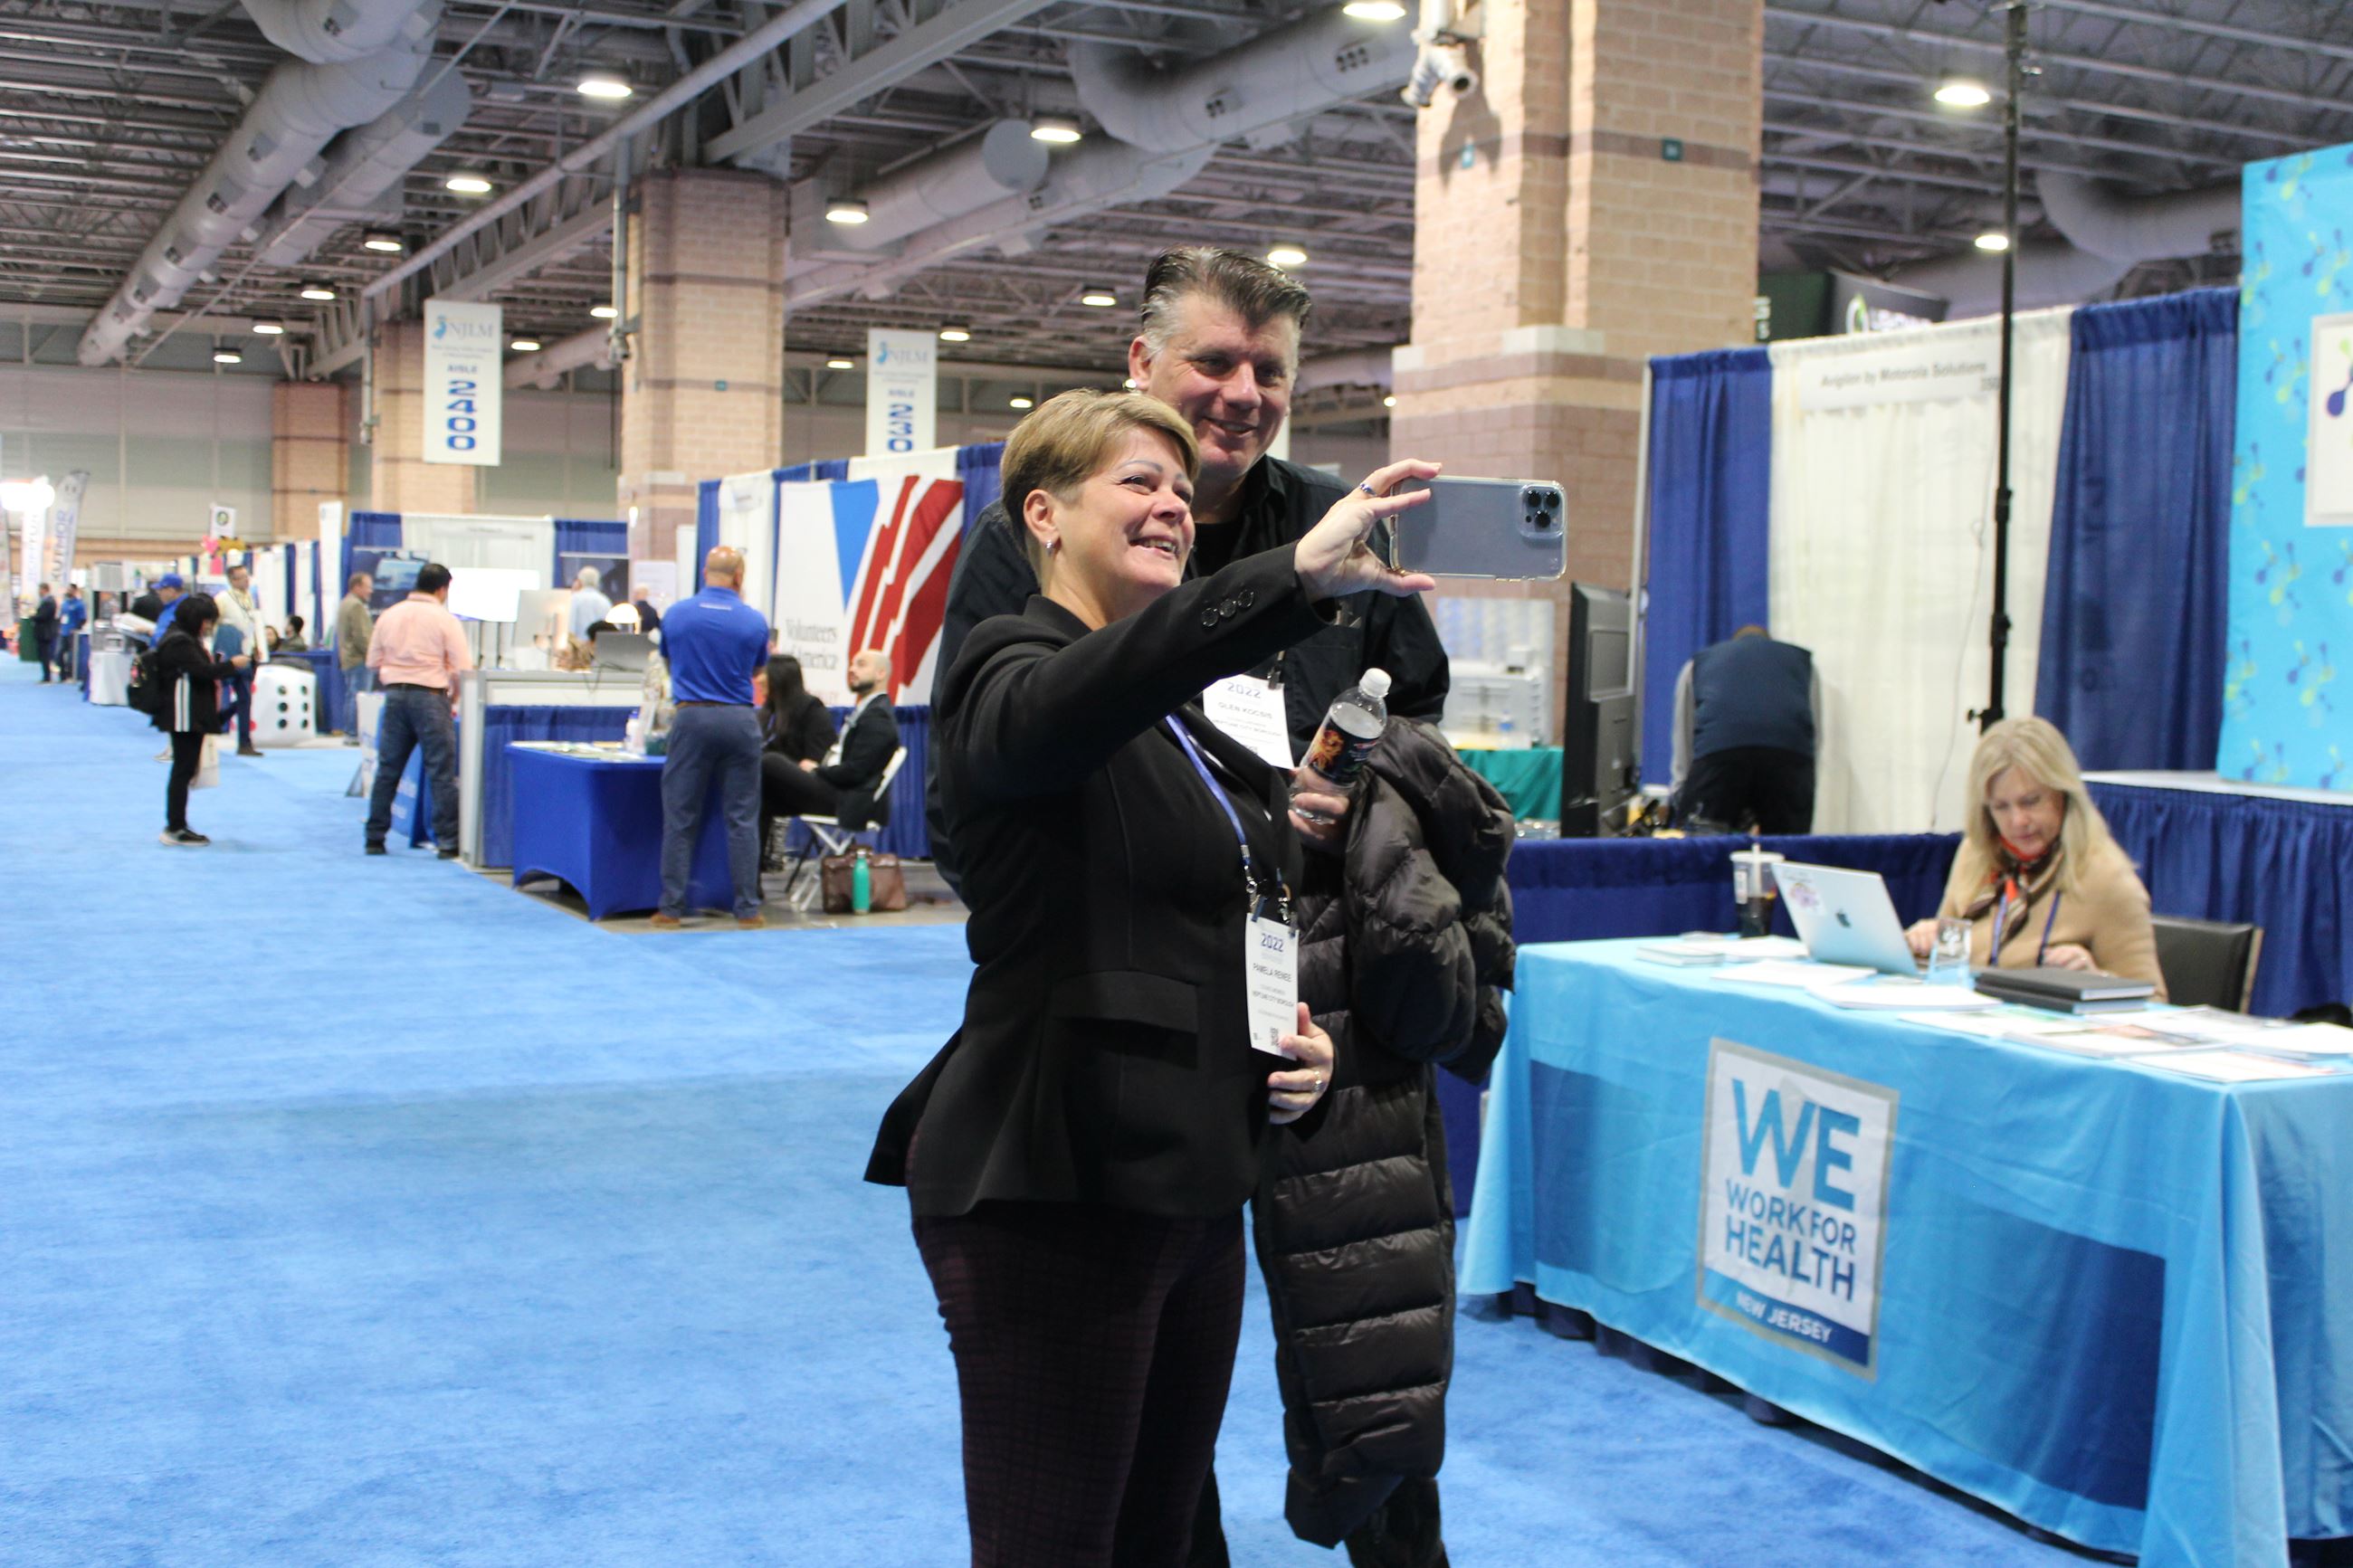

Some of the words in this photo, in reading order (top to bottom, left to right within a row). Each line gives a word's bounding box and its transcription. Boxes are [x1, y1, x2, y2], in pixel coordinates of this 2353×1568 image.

[450, 321, 494, 340] NJLM
[446, 364, 478, 374] AISLE
[446, 380, 478, 451] 2400
[1226, 680, 1262, 699] 2022
[1261, 932, 1284, 953] 2022
[1732, 1078, 1862, 1214] WE
[1725, 1178, 1807, 1237] WORK
[1810, 1210, 1857, 1256] FOR
[1725, 1213, 1854, 1303] HEALTH
[1737, 1290, 1767, 1319] NEW
[1767, 1307, 1834, 1344] JERSEY
